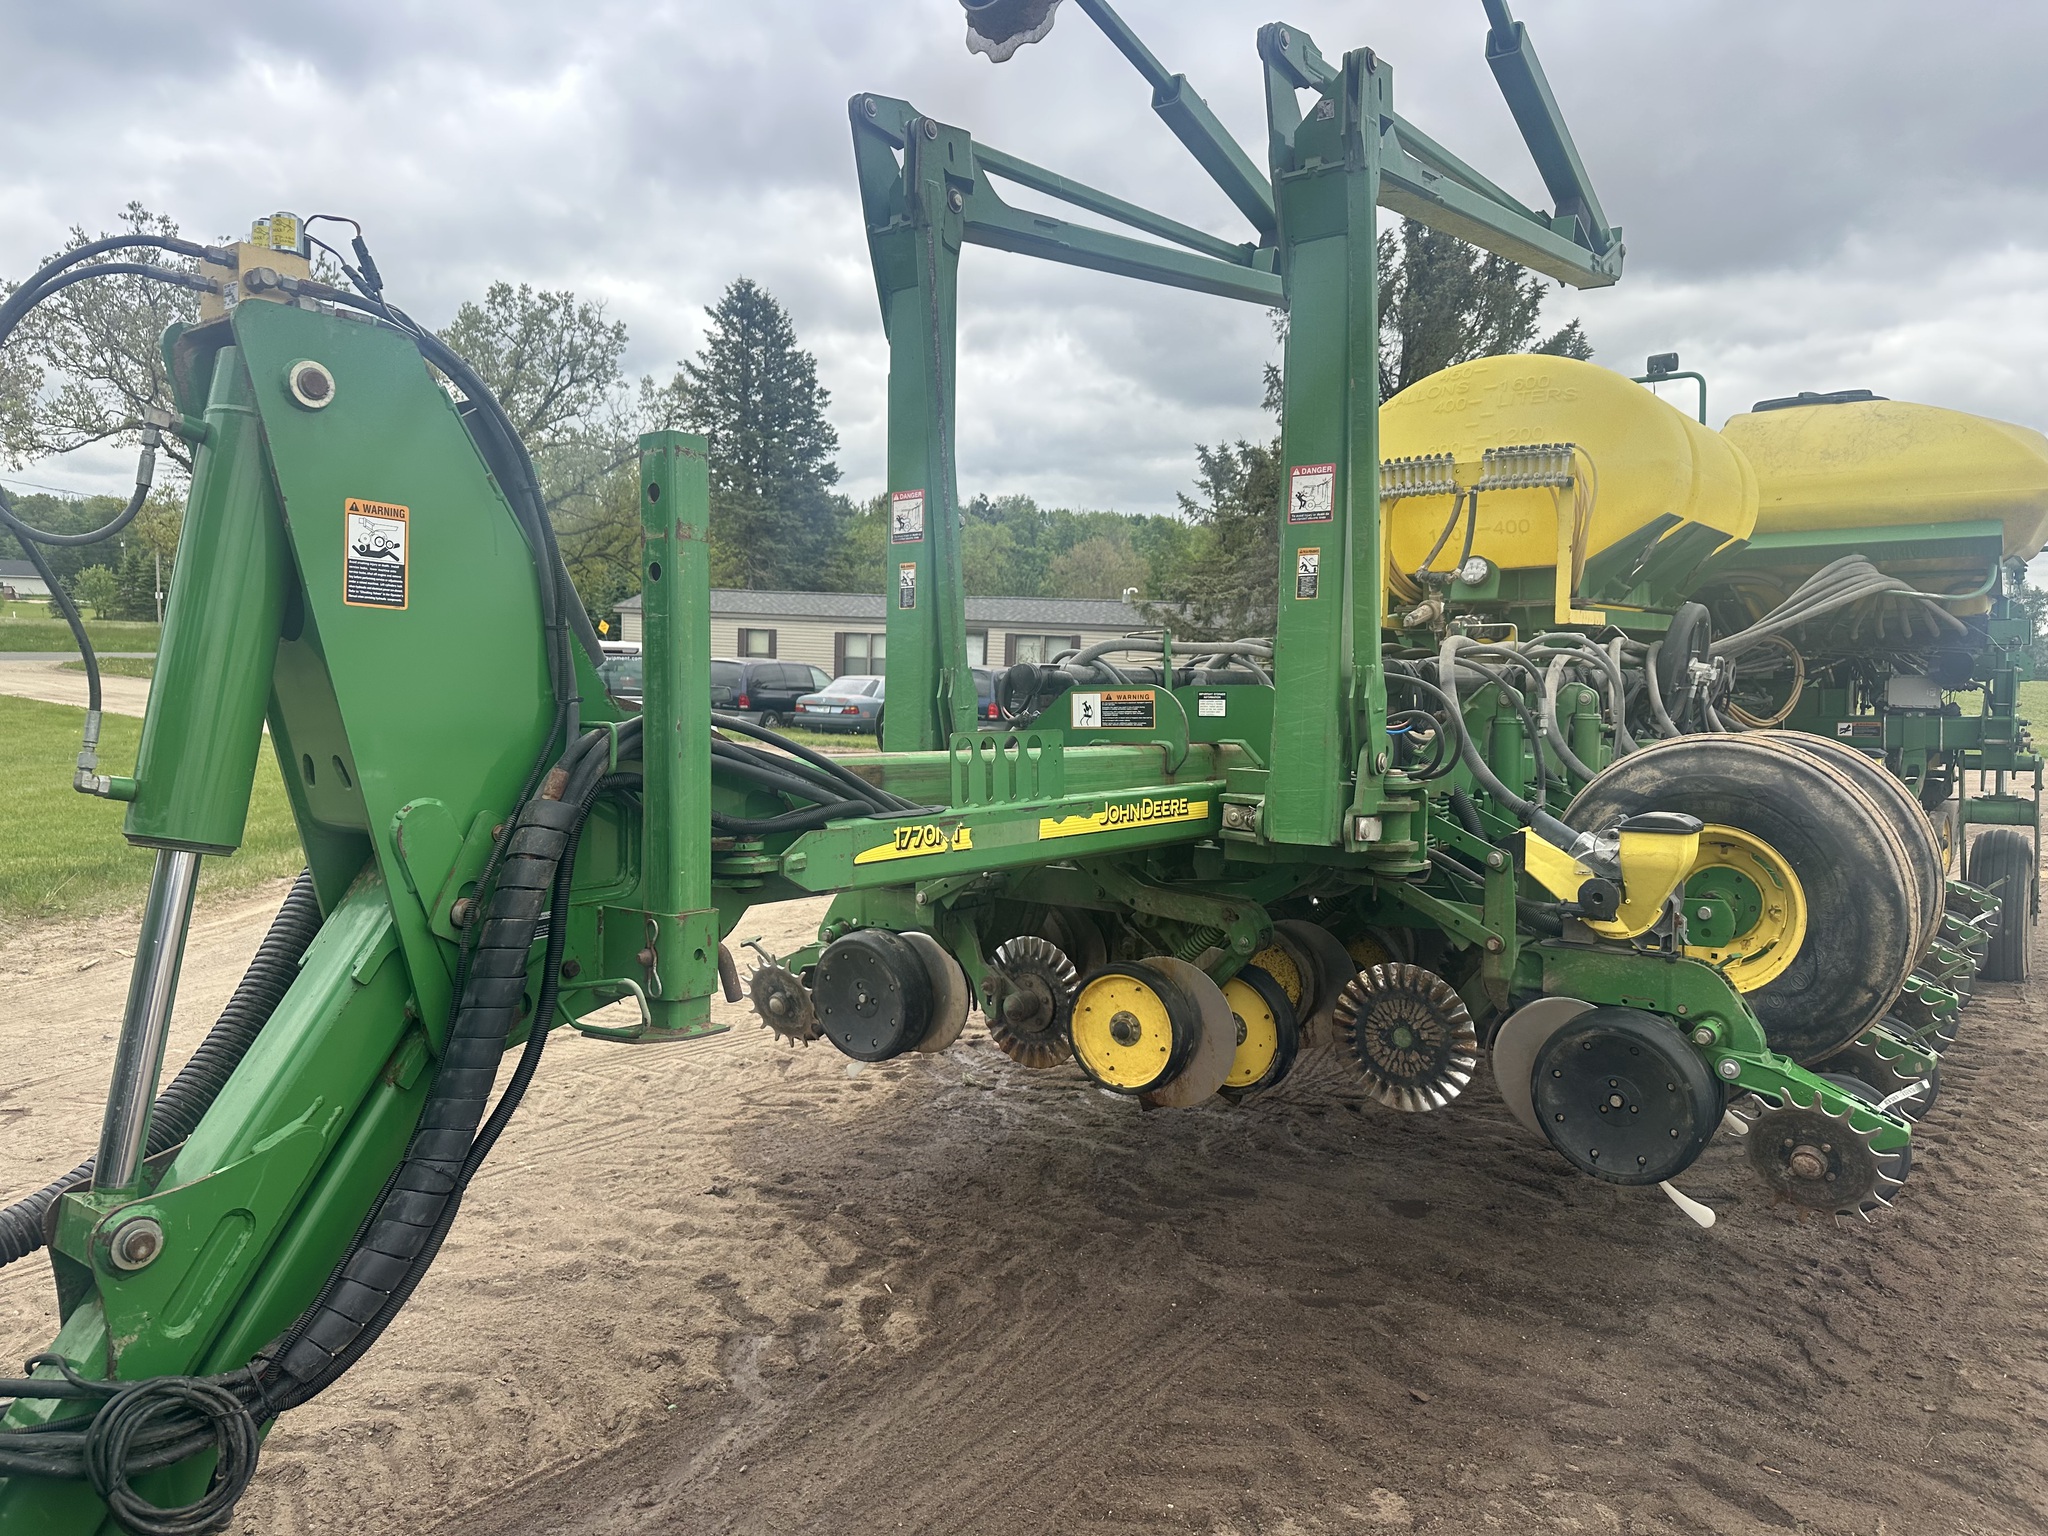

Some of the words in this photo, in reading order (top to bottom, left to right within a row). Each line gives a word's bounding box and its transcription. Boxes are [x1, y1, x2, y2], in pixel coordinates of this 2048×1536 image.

[1440, 366, 1473, 382] 450
[1500, 375, 1550, 393] 1600
[1381, 381, 1470, 412] GALLONS
[1497, 387, 1578, 408] LITERS
[1433, 398, 1467, 413] 400
[1494, 426, 1543, 444] 1200
[1301, 466, 1332, 475] DANGER
[900, 491, 922, 500] DANGER
[363, 504, 405, 518] WARNING
[1493, 519, 1530, 534] 400
[1429, 527, 1462, 542] 10
[1100, 801, 1141, 825] JOHN
[1142, 798, 1189, 819] DEERE
